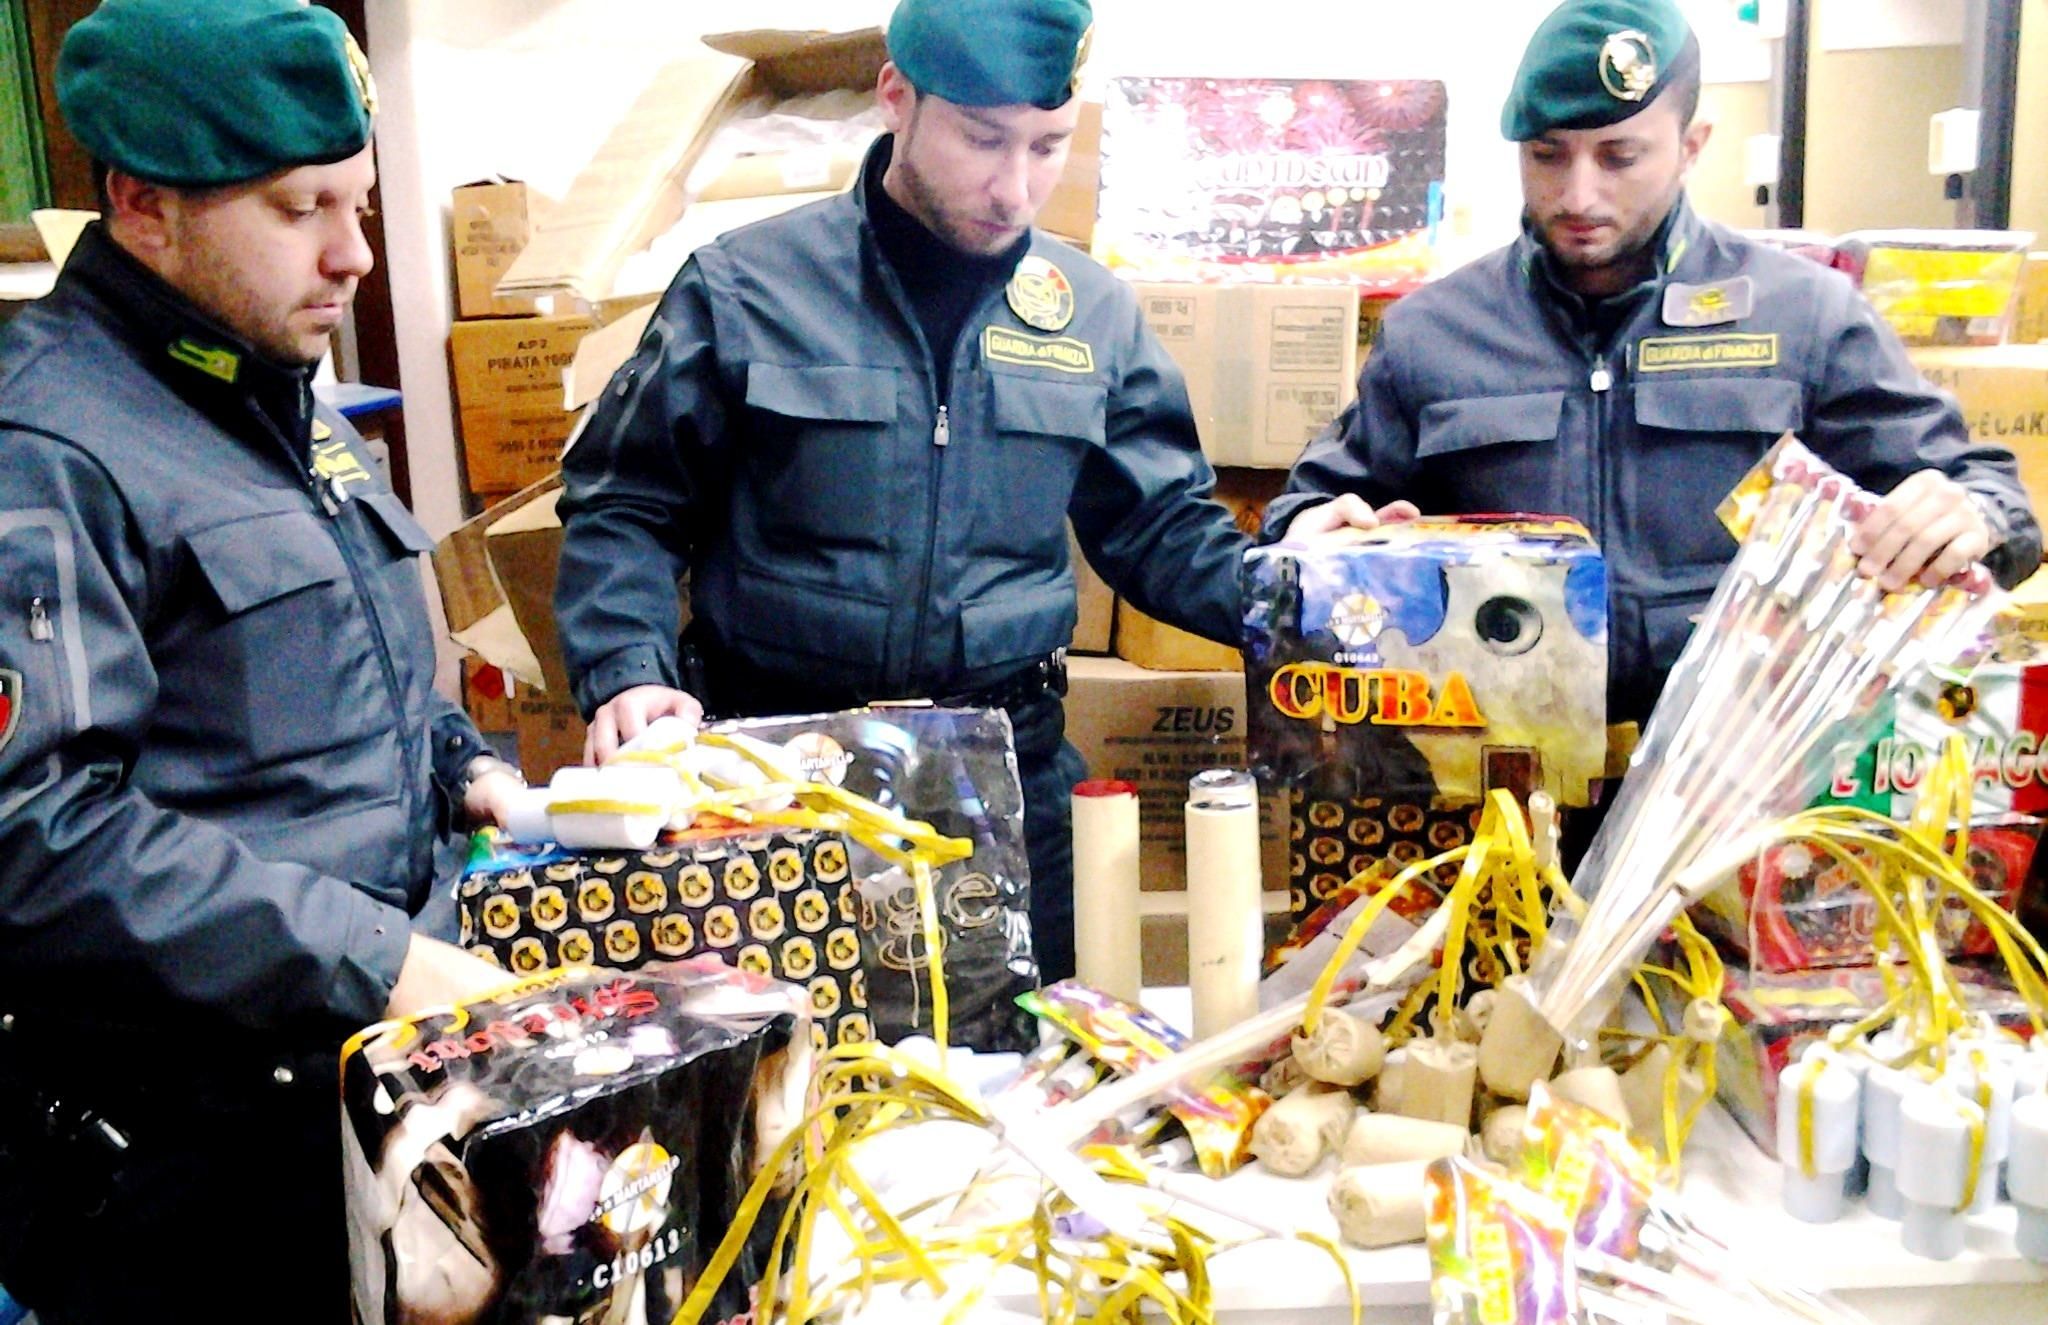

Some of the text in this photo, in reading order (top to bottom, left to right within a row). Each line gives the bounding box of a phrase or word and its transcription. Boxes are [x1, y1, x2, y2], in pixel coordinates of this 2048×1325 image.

[1152, 706, 1235, 733] ZEUS
[1269, 663, 1488, 727] CUBA
[1873, 736, 1928, 795] IO
[1938, 730, 2048, 790] AG
[592, 1231, 680, 1290] C10613
